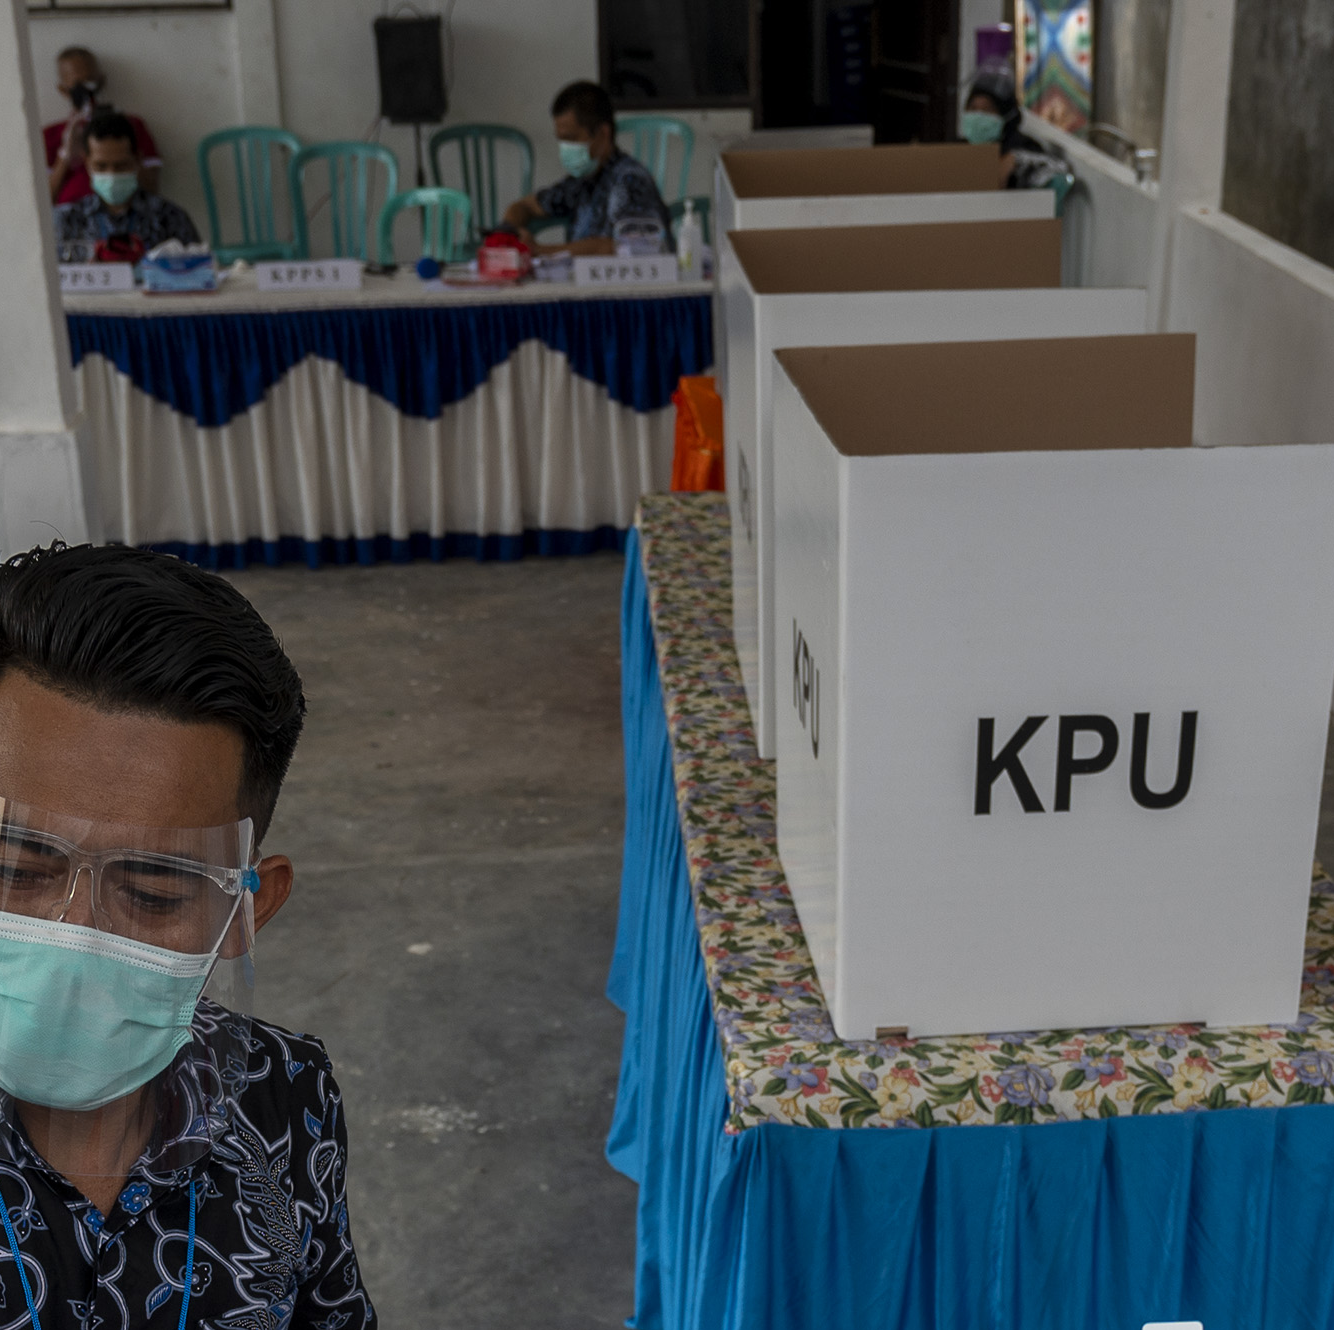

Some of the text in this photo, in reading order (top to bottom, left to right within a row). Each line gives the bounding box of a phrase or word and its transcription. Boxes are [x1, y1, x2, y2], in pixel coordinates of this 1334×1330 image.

[270, 266, 326, 283] KPPS
[589, 264, 643, 281] KPPS
[792, 617, 820, 760] KPU
[973, 710, 1199, 816] KPU
